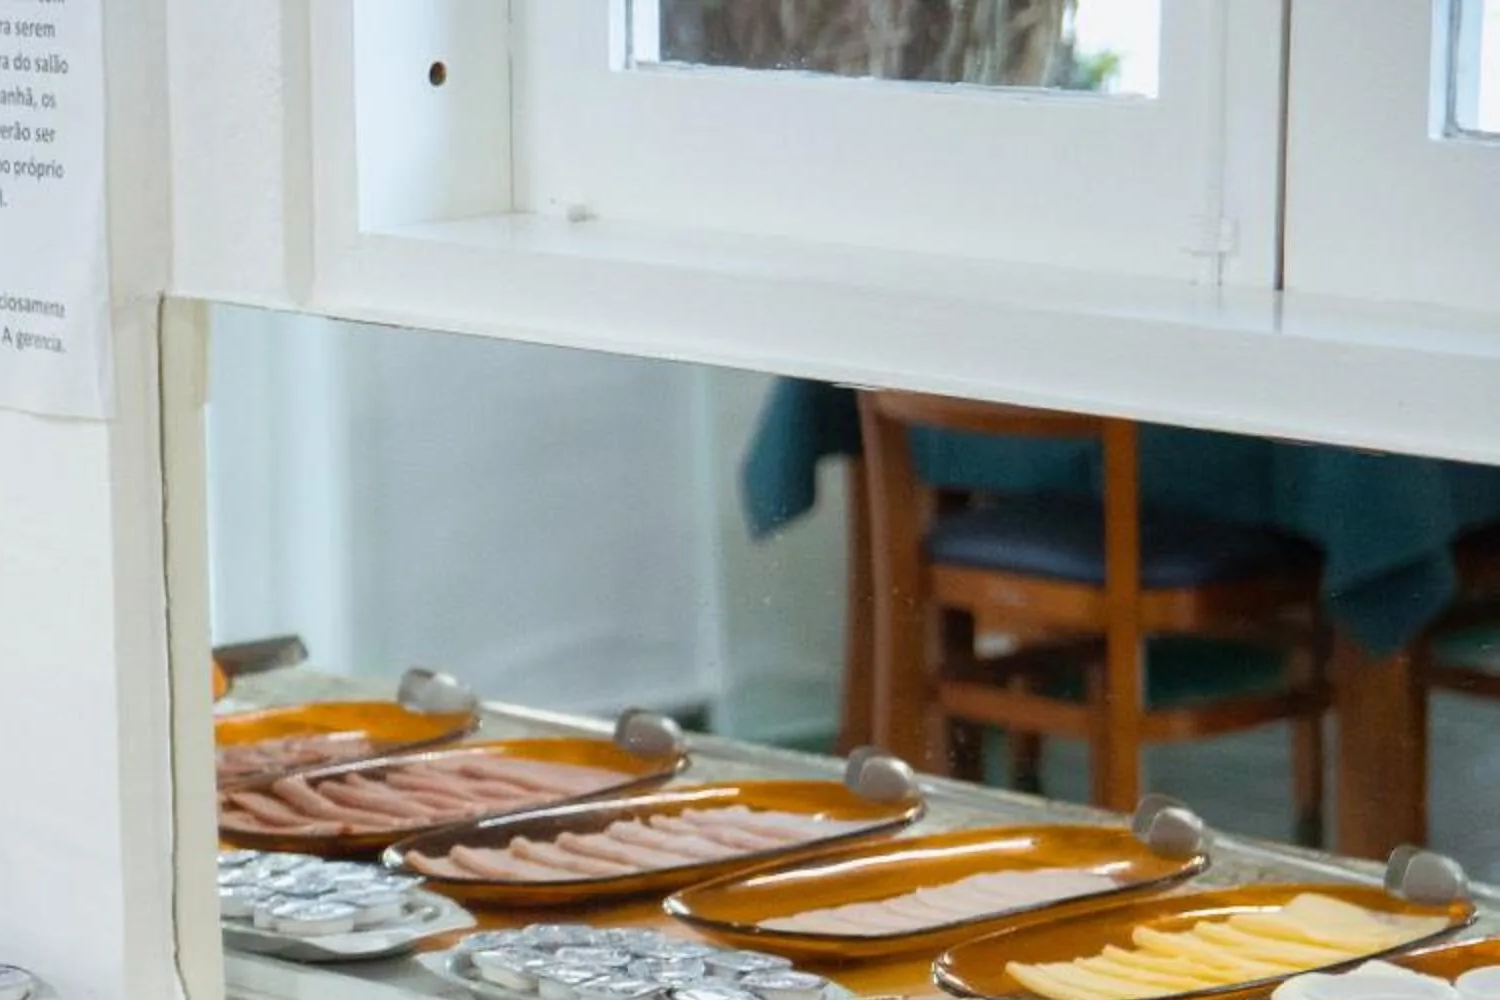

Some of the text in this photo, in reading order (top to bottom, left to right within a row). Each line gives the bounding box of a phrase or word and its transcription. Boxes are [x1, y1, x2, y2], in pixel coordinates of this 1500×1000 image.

[14, 20, 56, 38] serem
[13, 52, 31, 72] do
[34, 52, 69, 75] salão
[41, 93, 56, 110] os
[35, 127, 56, 143] ser
[13, 154, 65, 184] próprio
[1, 326, 13, 344] A
